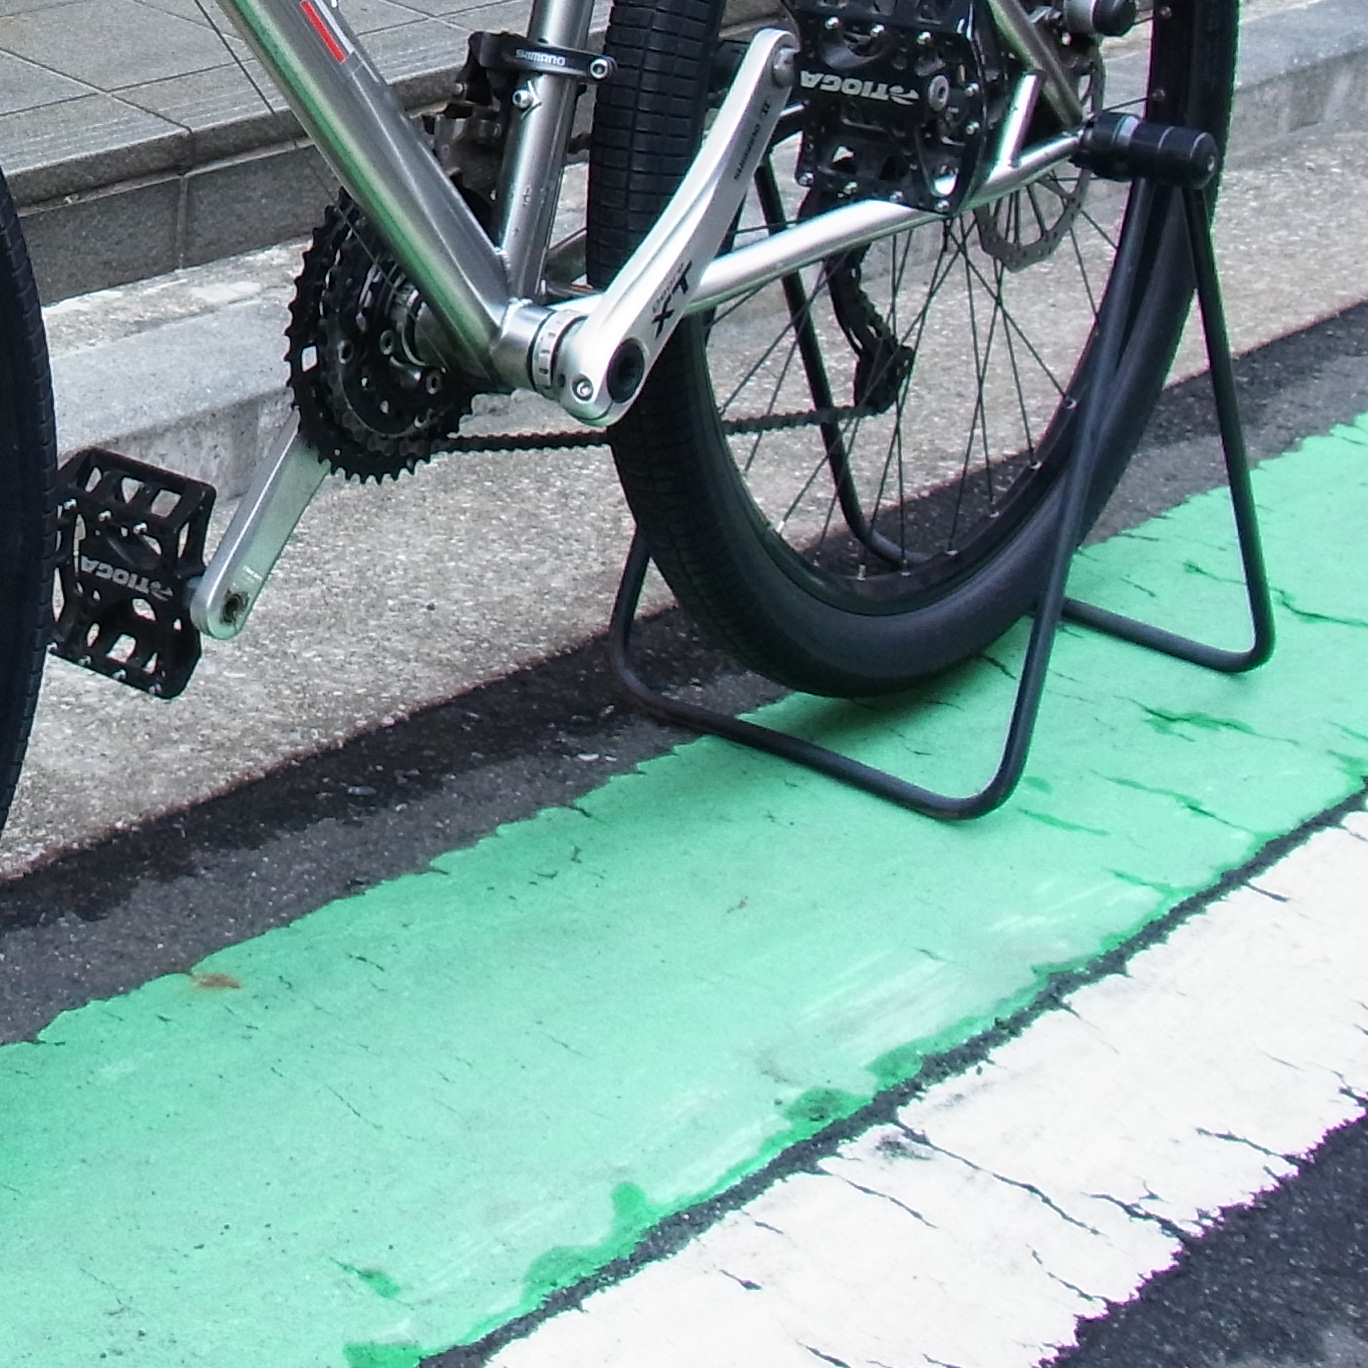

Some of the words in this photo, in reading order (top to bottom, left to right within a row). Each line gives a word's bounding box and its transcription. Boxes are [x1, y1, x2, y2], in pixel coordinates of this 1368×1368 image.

[799, 70, 890, 101] TIOGA
[651, 260, 693, 340] XT
[80, 554, 151, 595] TIOGA
